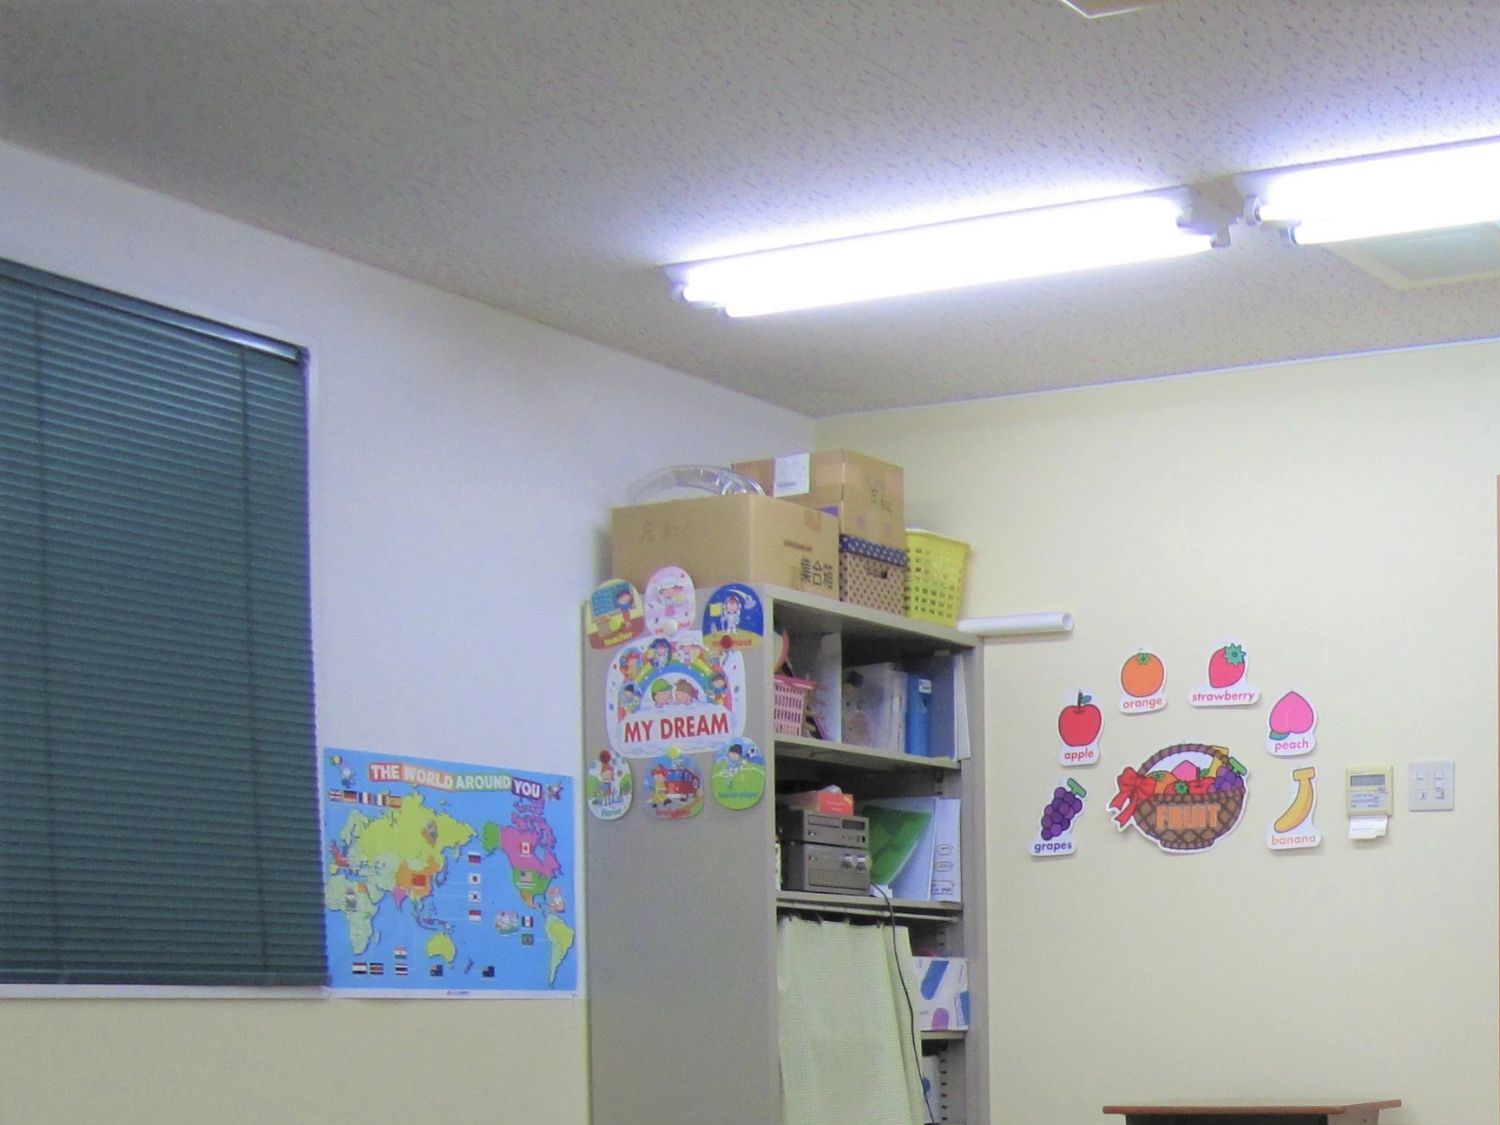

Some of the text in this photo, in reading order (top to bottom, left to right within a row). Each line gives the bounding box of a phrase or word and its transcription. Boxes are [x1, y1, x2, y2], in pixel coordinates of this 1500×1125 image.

[1122, 695, 1163, 710] orange
[1191, 689, 1255, 702] strawberry
[625, 713, 728, 743] MY DREAM
[1274, 738, 1309, 752] peach
[1064, 748, 1094, 762] apple
[370, 764, 540, 798] THE WORLD AROUND YOU
[1156, 803, 1219, 829] FRUIT
[1034, 840, 1072, 853] grapes
[1271, 834, 1316, 846] banana
